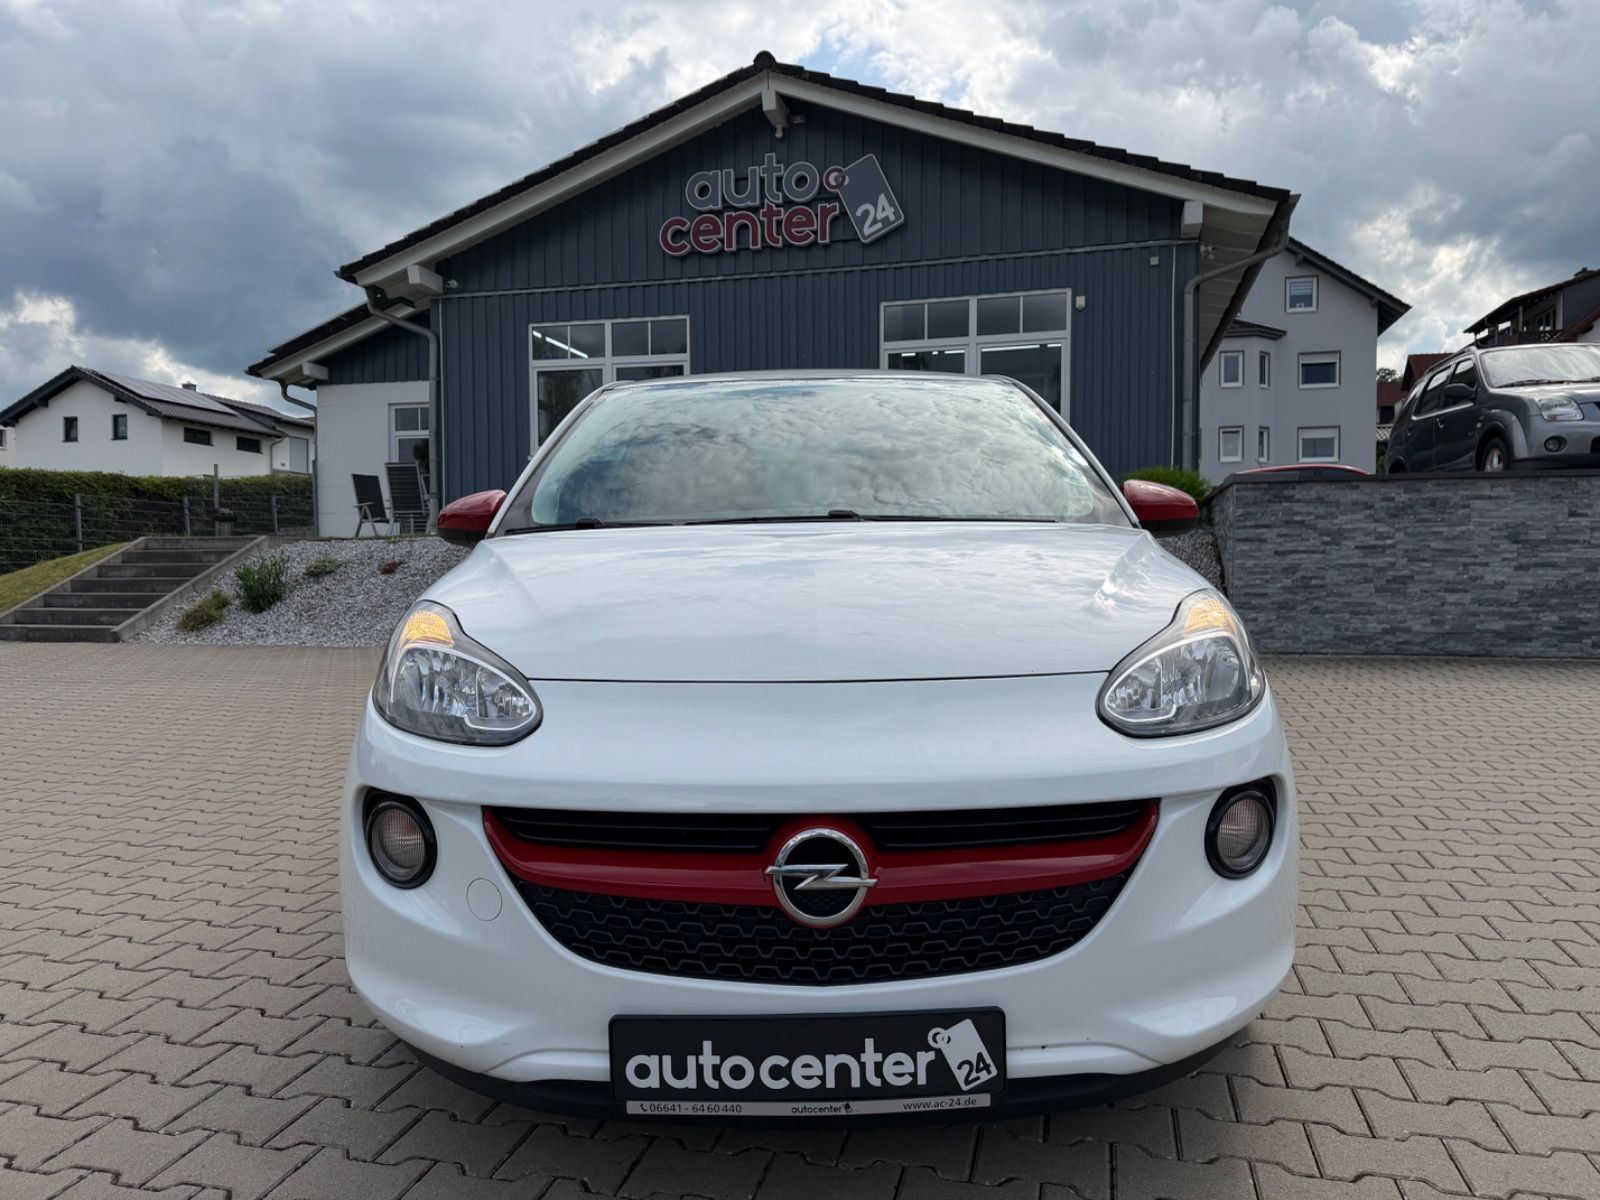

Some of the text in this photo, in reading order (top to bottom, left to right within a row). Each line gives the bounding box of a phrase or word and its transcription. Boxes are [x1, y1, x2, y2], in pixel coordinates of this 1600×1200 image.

[686, 153, 820, 211] auto
[659, 200, 839, 256] center
[855, 193, 896, 236] 24
[956, 1051, 992, 1086] 24
[791, 1104, 842, 1114] autocenter
[903, 1097, 977, 1110] www.ac-24.de
